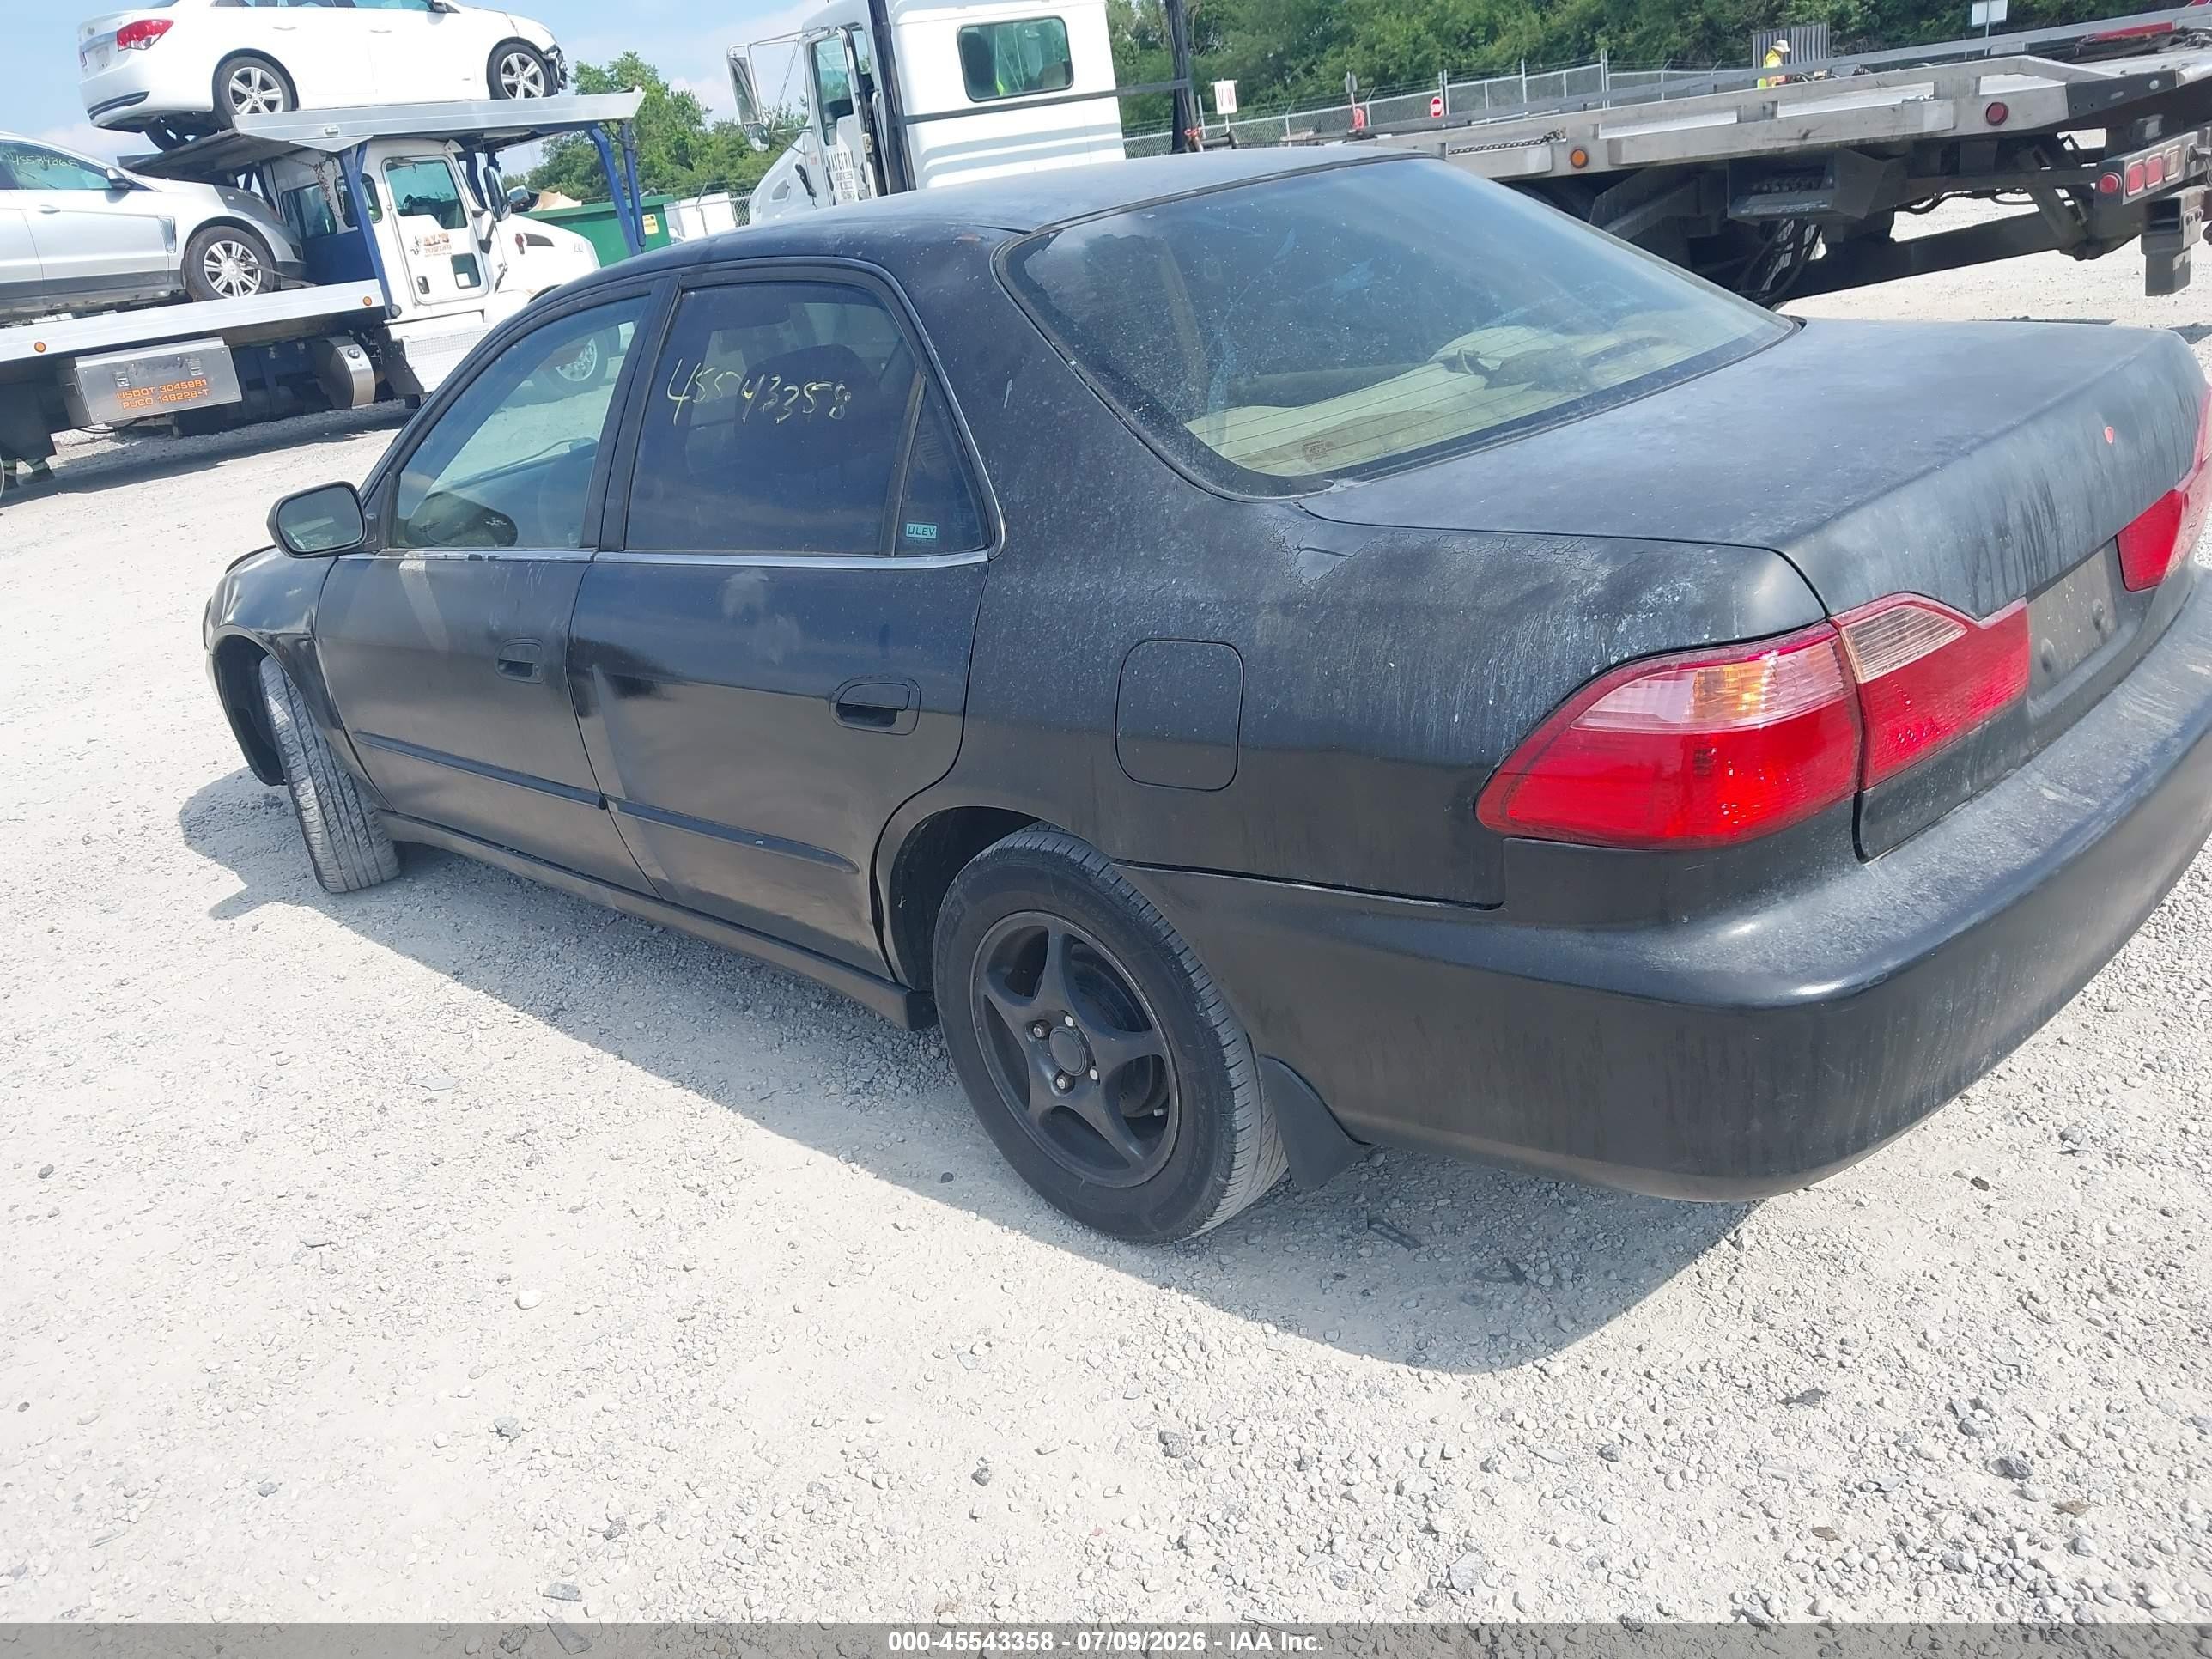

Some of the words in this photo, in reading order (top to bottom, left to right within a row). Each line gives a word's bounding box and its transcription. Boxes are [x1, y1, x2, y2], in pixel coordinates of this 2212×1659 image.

[117, 386, 155, 400] USDOT
[667, 358, 852, 426] 45543358
[122, 398, 154, 410] PUCO
[908, 526, 935, 536] ULEV
